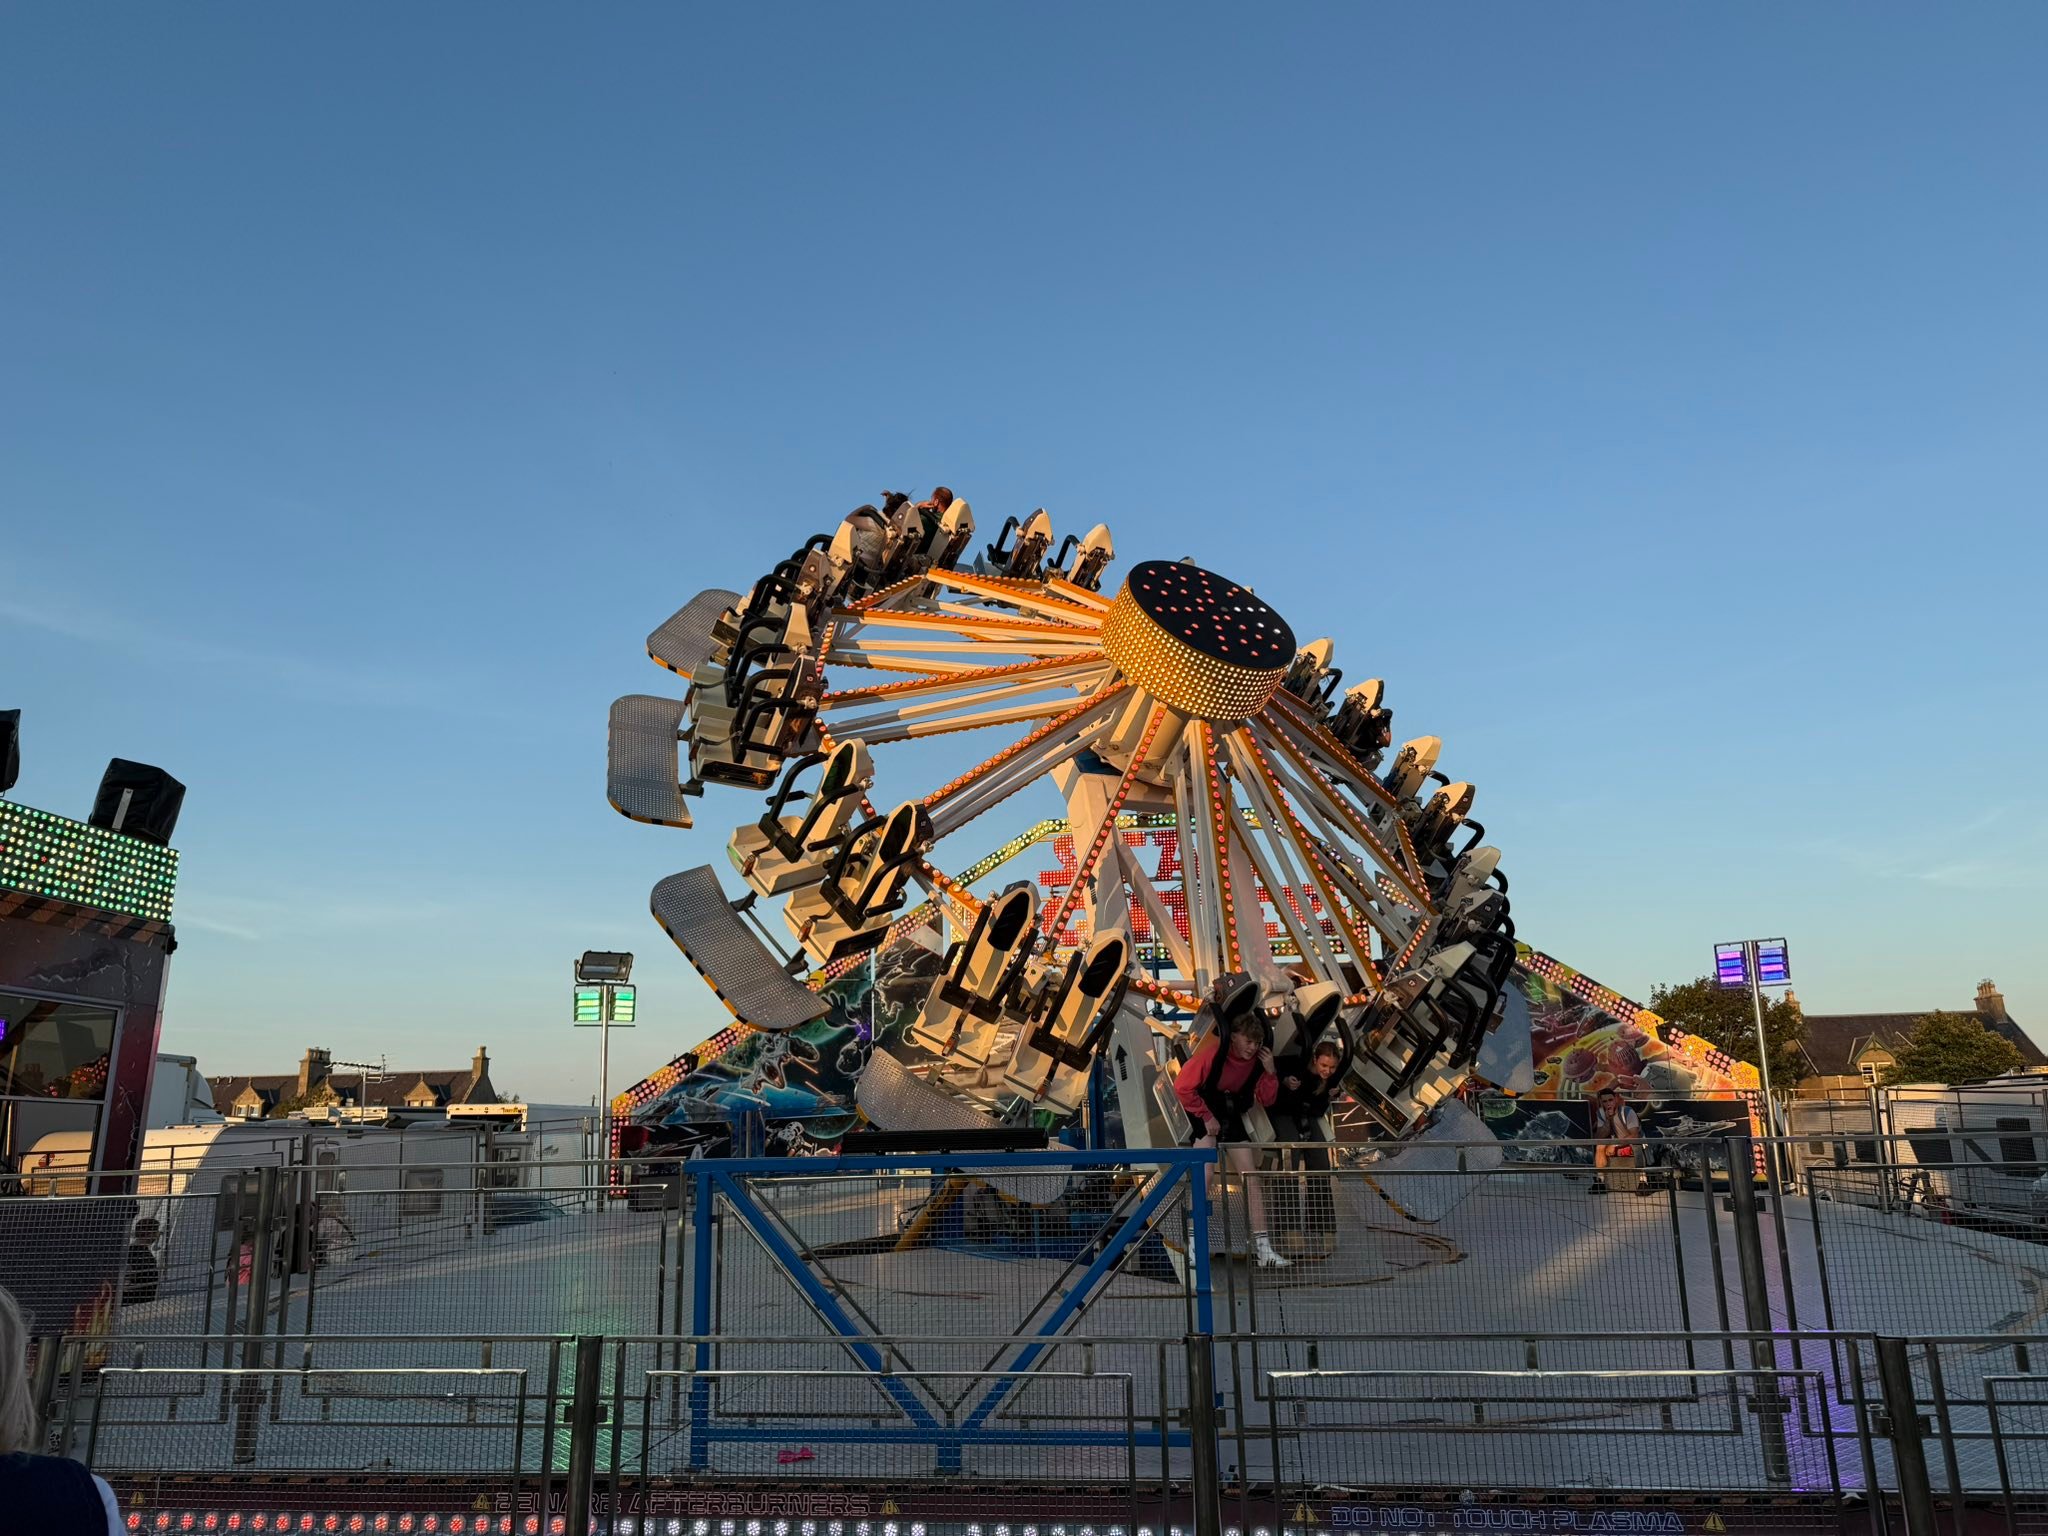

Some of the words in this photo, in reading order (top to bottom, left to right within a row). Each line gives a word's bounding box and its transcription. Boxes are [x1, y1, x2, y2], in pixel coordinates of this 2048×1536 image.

[496, 1492, 621, 1514] BEWE
[628, 1492, 871, 1517] AFTERBURNERS
[1331, 1507, 1373, 1526] DO
[1553, 1510, 1685, 1532] PLASMA
